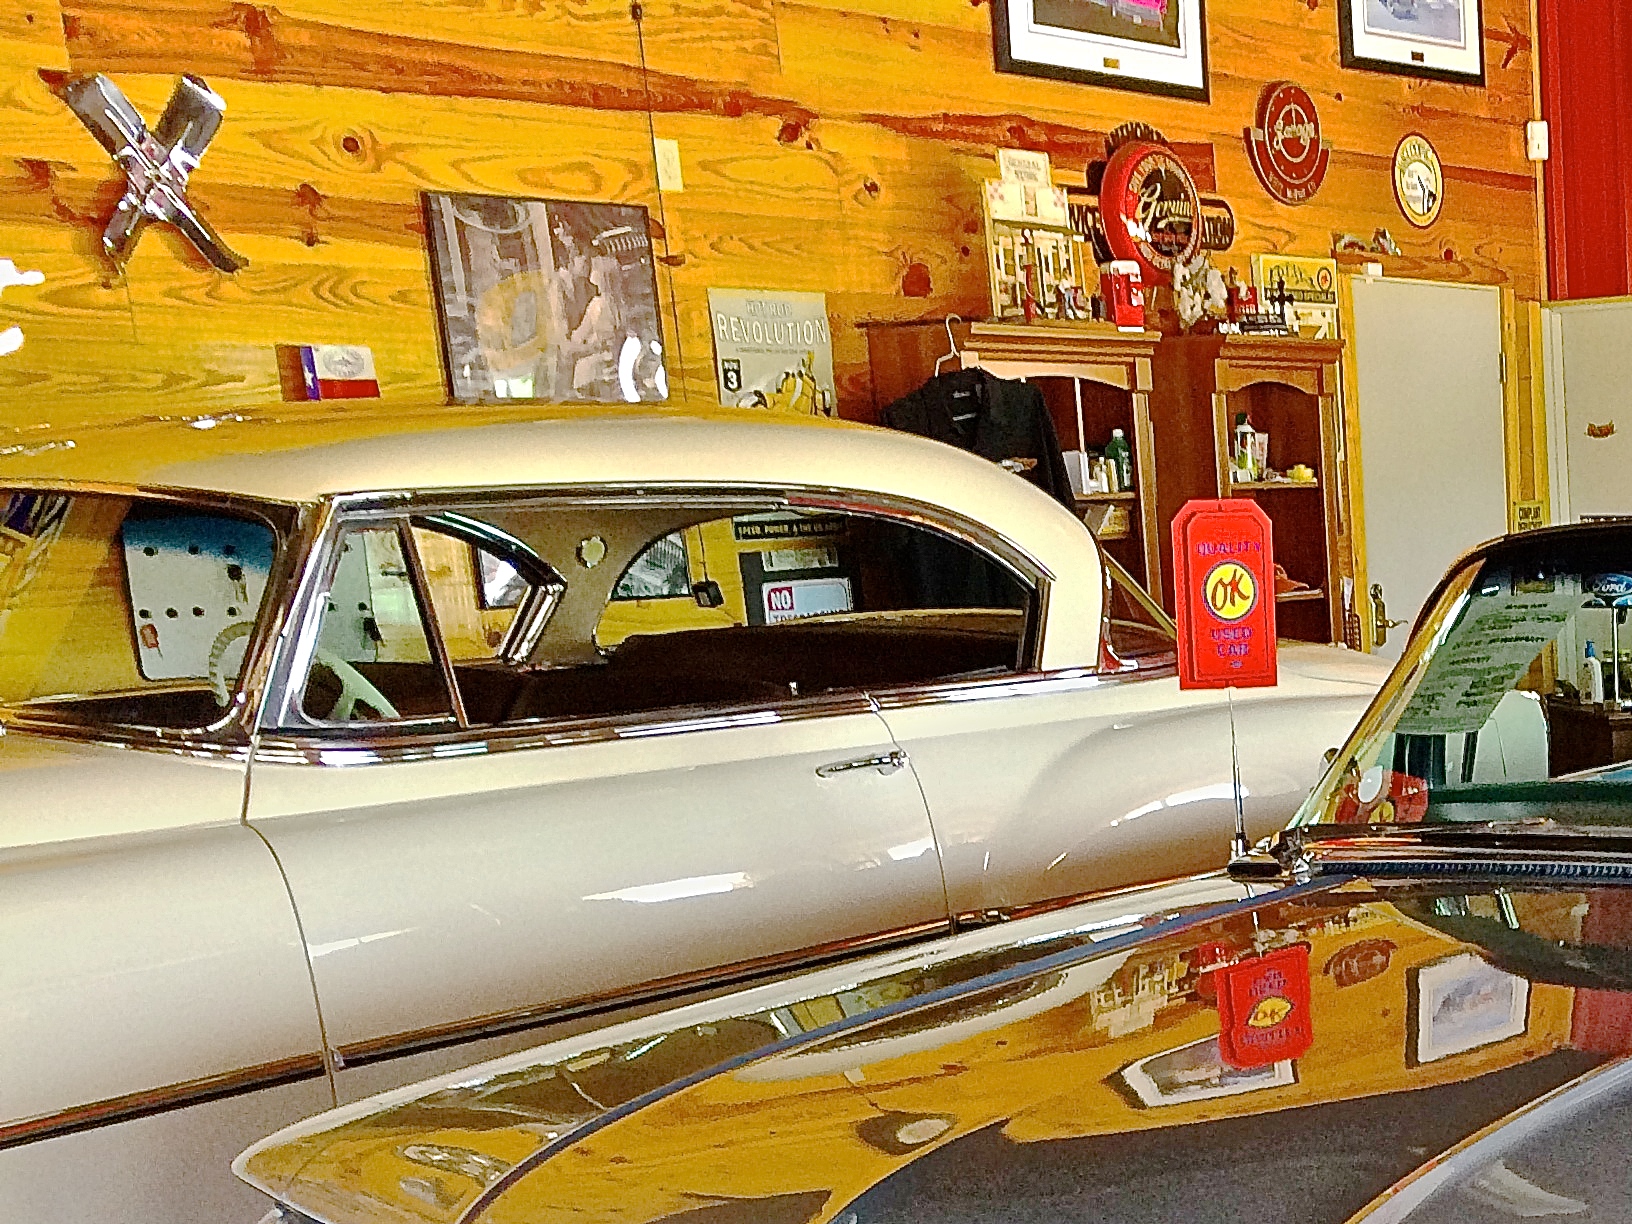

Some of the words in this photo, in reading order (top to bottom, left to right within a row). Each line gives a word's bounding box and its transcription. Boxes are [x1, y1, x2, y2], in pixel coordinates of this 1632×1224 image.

[716, 312, 826, 345] REVOLUTION
[727, 371, 738, 389] 3
[1196, 541, 1262, 556] QUALITY
[770, 588, 790, 610] NO
[1210, 568, 1251, 612] OK
[1210, 626, 1253, 642] USED
[1216, 642, 1250, 658] CAR
